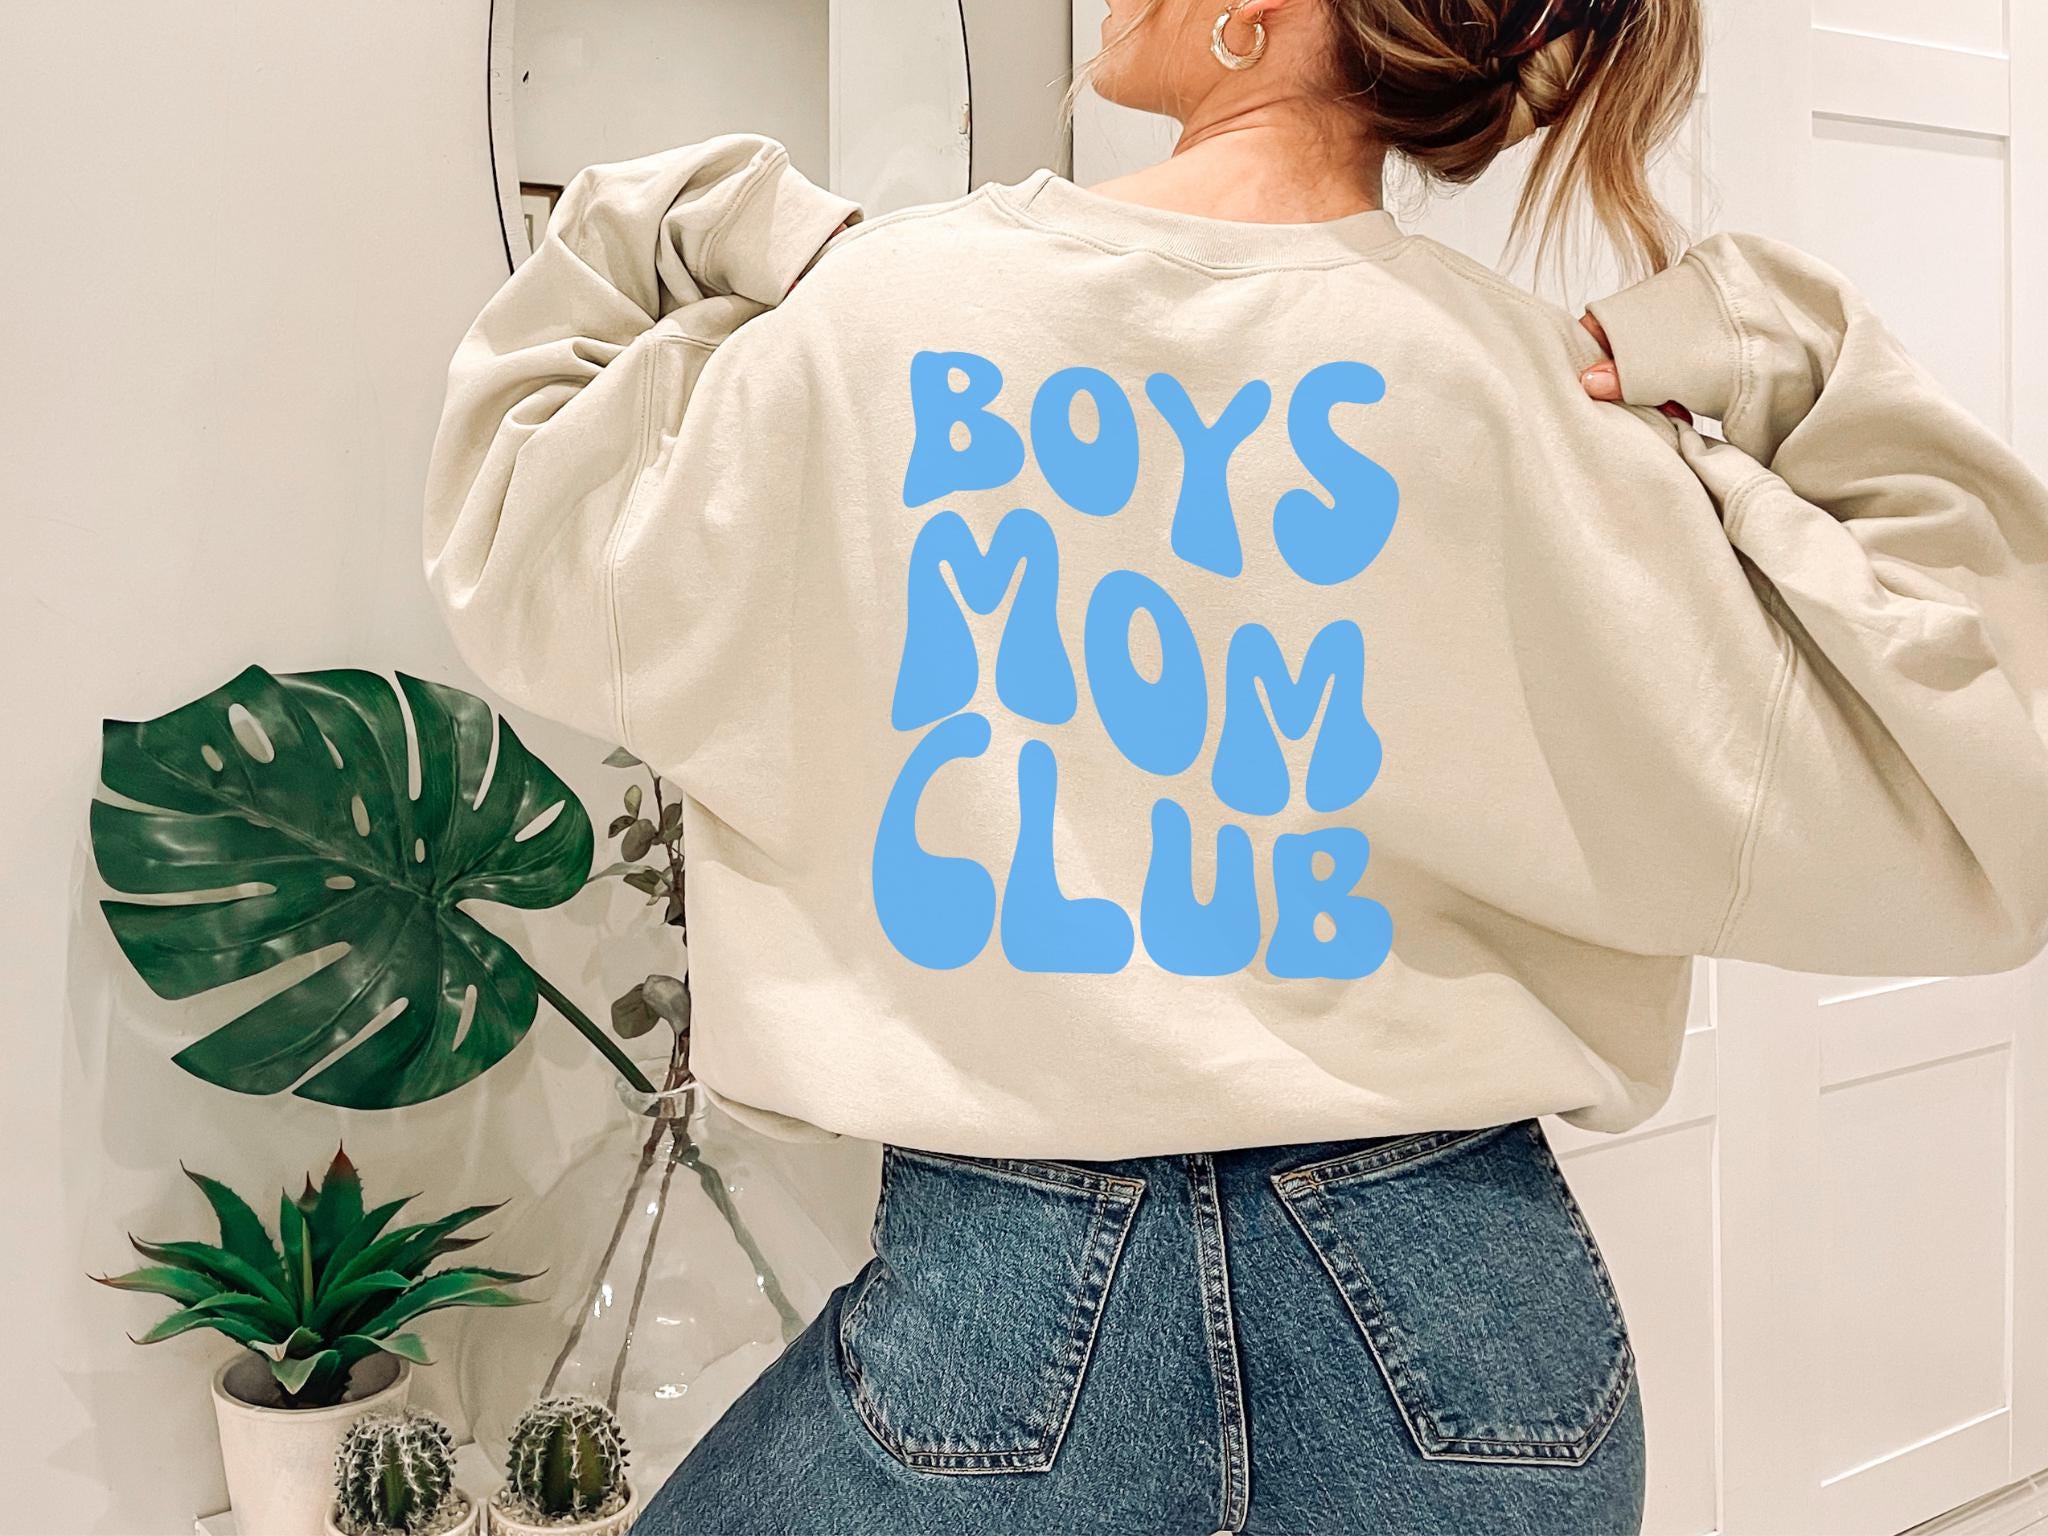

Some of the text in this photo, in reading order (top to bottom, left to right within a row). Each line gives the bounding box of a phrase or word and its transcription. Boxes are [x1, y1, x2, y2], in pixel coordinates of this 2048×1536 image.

[904, 351, 1399, 585] BOYS
[892, 508, 1382, 816] MOM
[872, 712, 1393, 980] CLUB
